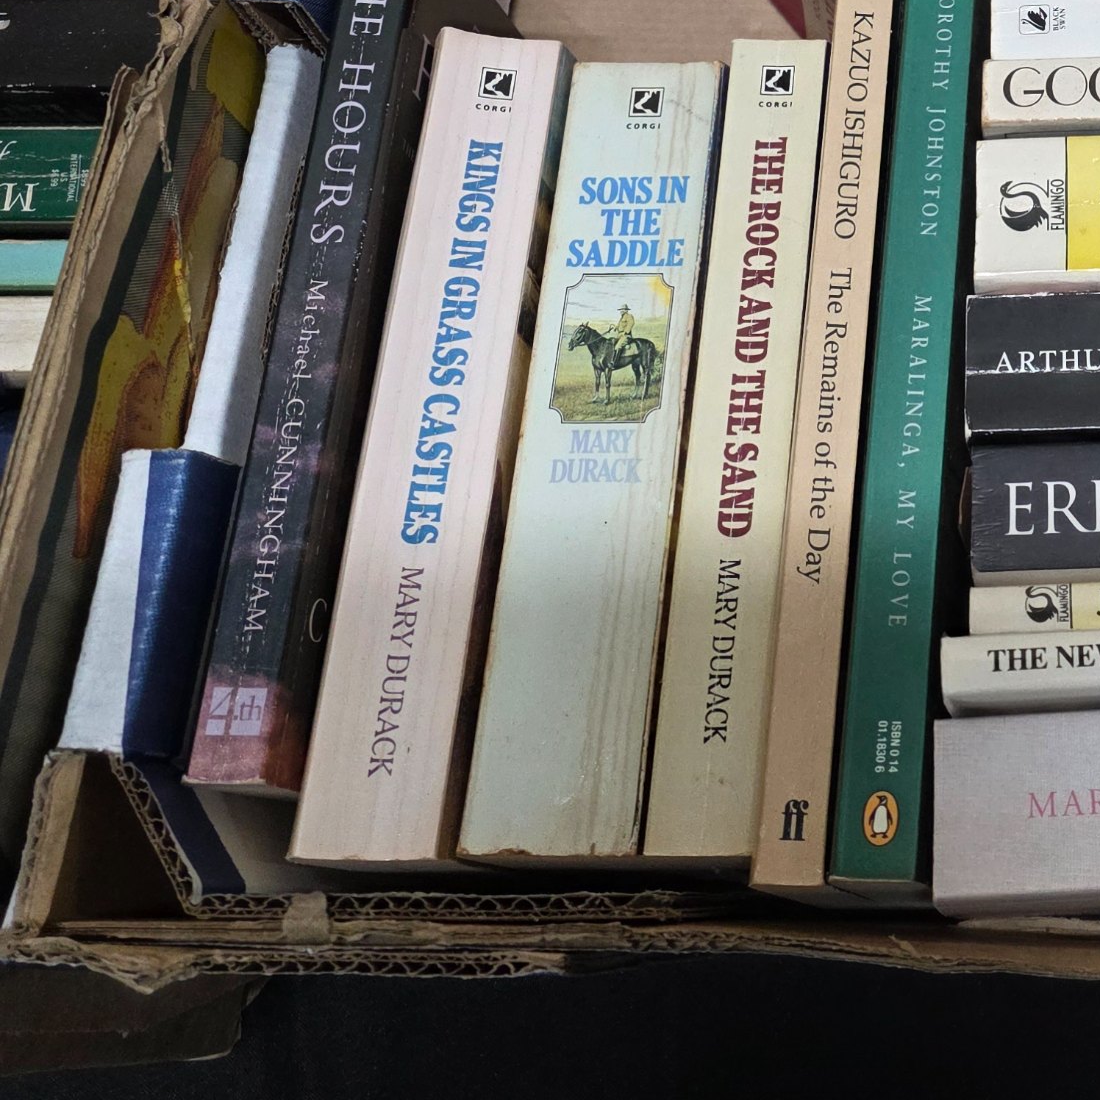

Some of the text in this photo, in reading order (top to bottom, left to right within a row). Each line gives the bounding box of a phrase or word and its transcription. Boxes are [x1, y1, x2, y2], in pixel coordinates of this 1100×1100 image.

[475, 102, 513, 114] CORGI
[310, 60, 376, 246] HOURS
[920, 106, 947, 237] JOHNSTON
[579, 175, 690, 205] SONS IN
[1050, 178, 1065, 231] FLAMINGO
[600, 208, 662, 236] THE
[566, 239, 685, 268] SADDLE
[291, 278, 329, 380] Michael
[896, 295, 932, 468] MARALINGA,
[367, 138, 504, 778] KINGS IN GRASS CASTLES MARY DURACK
[569, 429, 636, 454] MARY
[549, 459, 642, 484] DURACK
[242, 398, 306, 633] CUNNINGHAM
[895, 489, 917, 529] MY
[888, 552, 912, 626] LOVE
[874, 720, 888, 773] 01.1830 6
[891, 720, 902, 747] ISBN
[888, 760, 898, 773] 14
